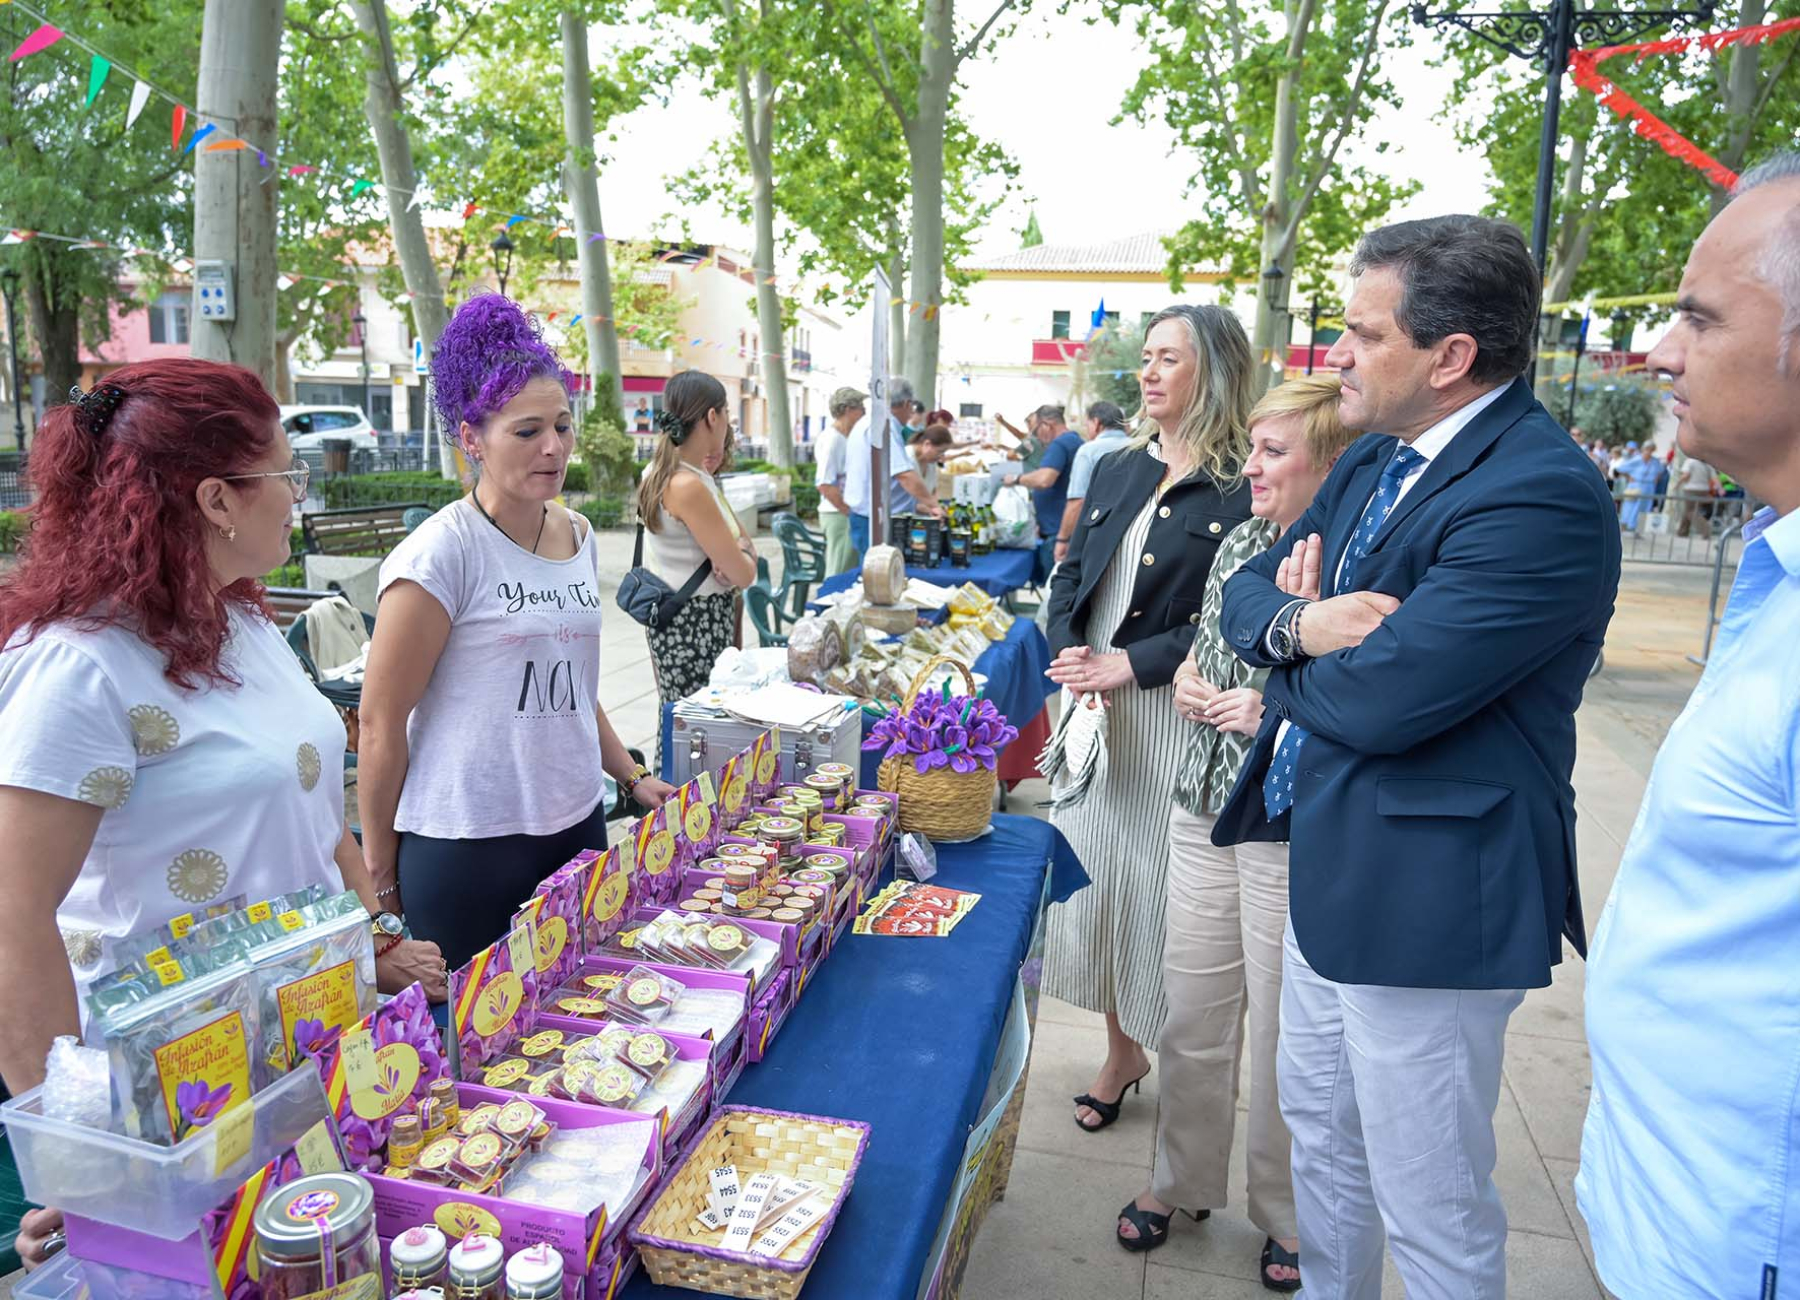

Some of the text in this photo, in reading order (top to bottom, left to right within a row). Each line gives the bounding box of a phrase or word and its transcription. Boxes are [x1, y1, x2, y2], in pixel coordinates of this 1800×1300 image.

[497, 582, 566, 613] Your
[281, 976, 330, 1006] Infusión
[295, 987, 342, 1017] Azafrán
[159, 1032, 212, 1067] Infusión
[176, 1043, 229, 1079] Azafrán
[715, 1165, 733, 1178] 5545
[720, 1184, 737, 1198] 5544
[745, 1194, 763, 1203] 5533
[738, 1209, 756, 1219] 5532
[796, 1206, 813, 1218] 5521
[784, 1216, 802, 1227] 5522
[731, 1226, 750, 1236] 5531
[772, 1226, 790, 1237] 5523
[760, 1237, 779, 1248] 5524
